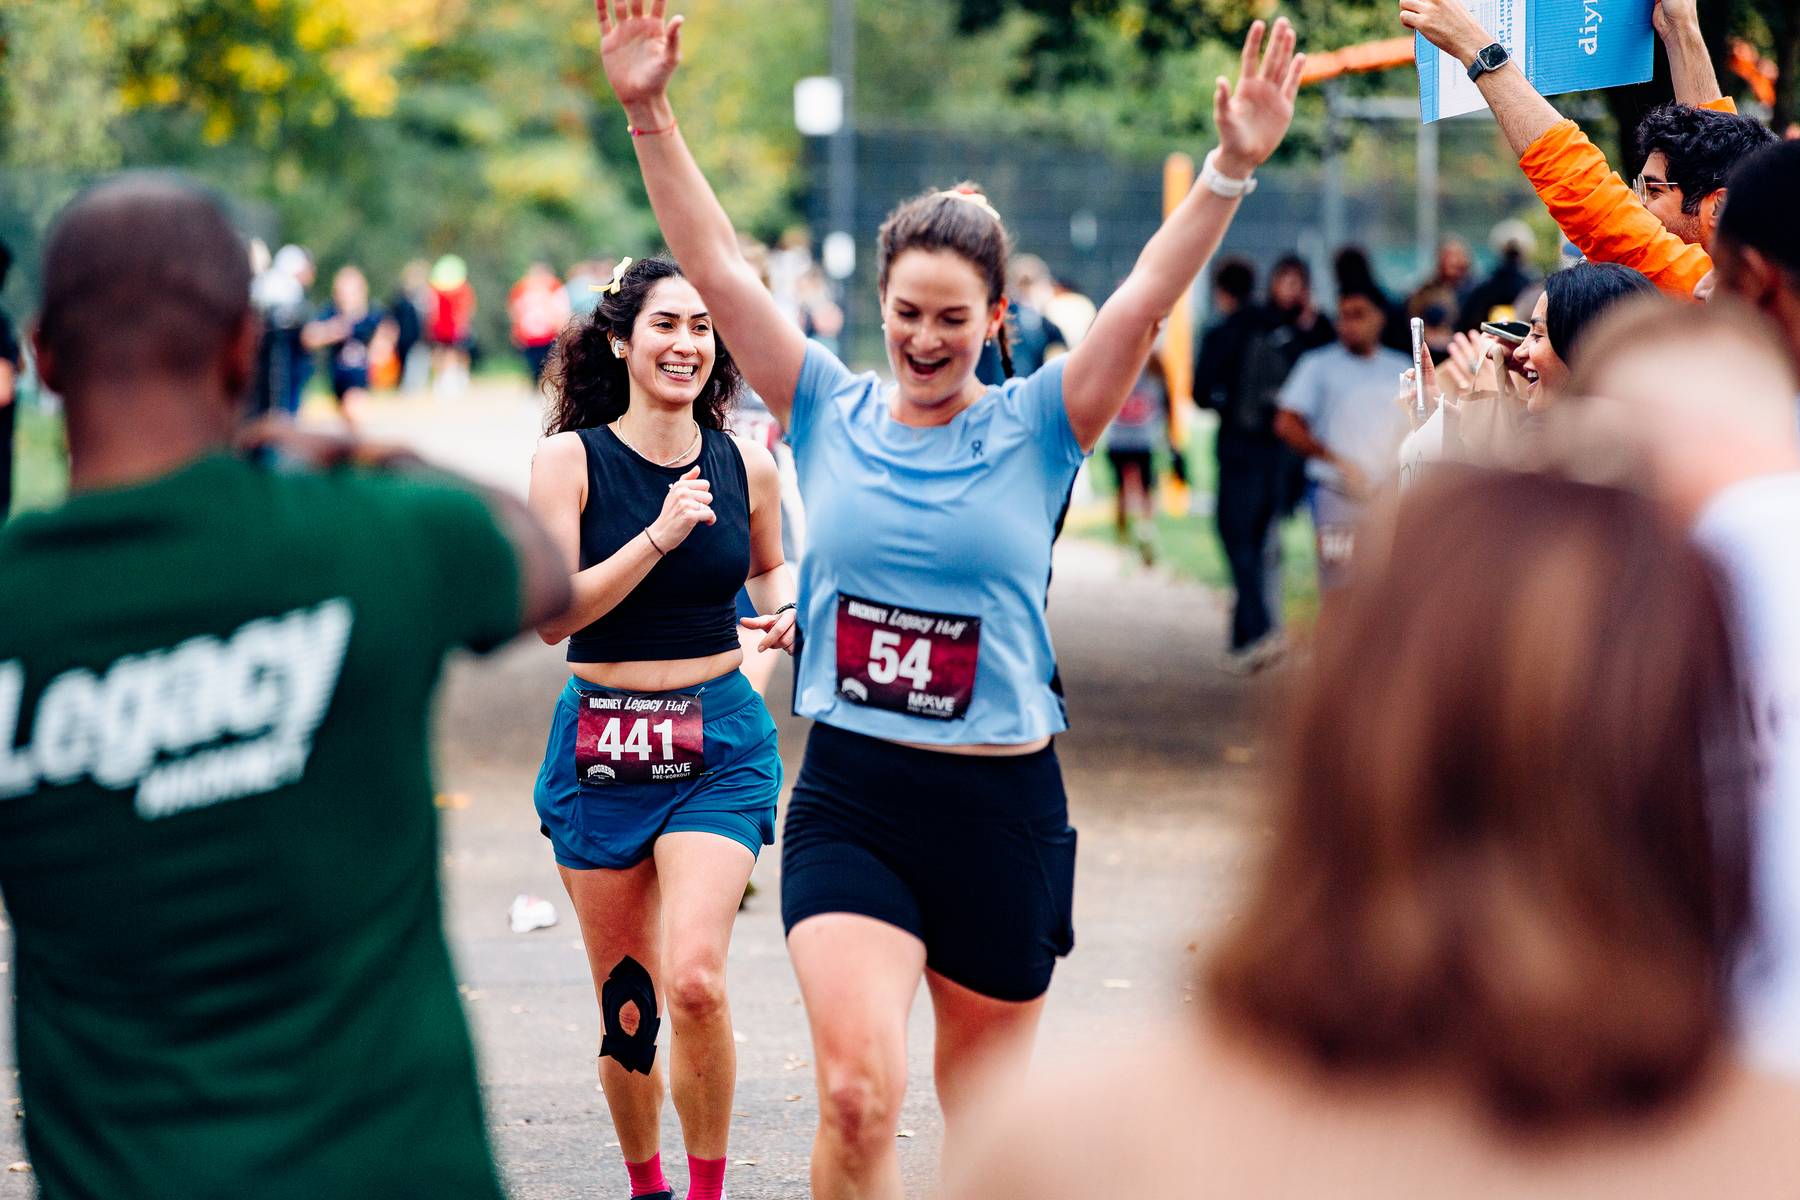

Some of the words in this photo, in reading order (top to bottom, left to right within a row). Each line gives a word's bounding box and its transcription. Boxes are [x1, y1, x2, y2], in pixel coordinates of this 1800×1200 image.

[867, 629, 933, 690] 54
[589, 697, 622, 710] HACKNEY
[624, 697, 663, 712] Legacy
[664, 700, 690, 714] Half
[597, 717, 674, 760] 441
[652, 772, 691, 780] PRE-WORKOUT
